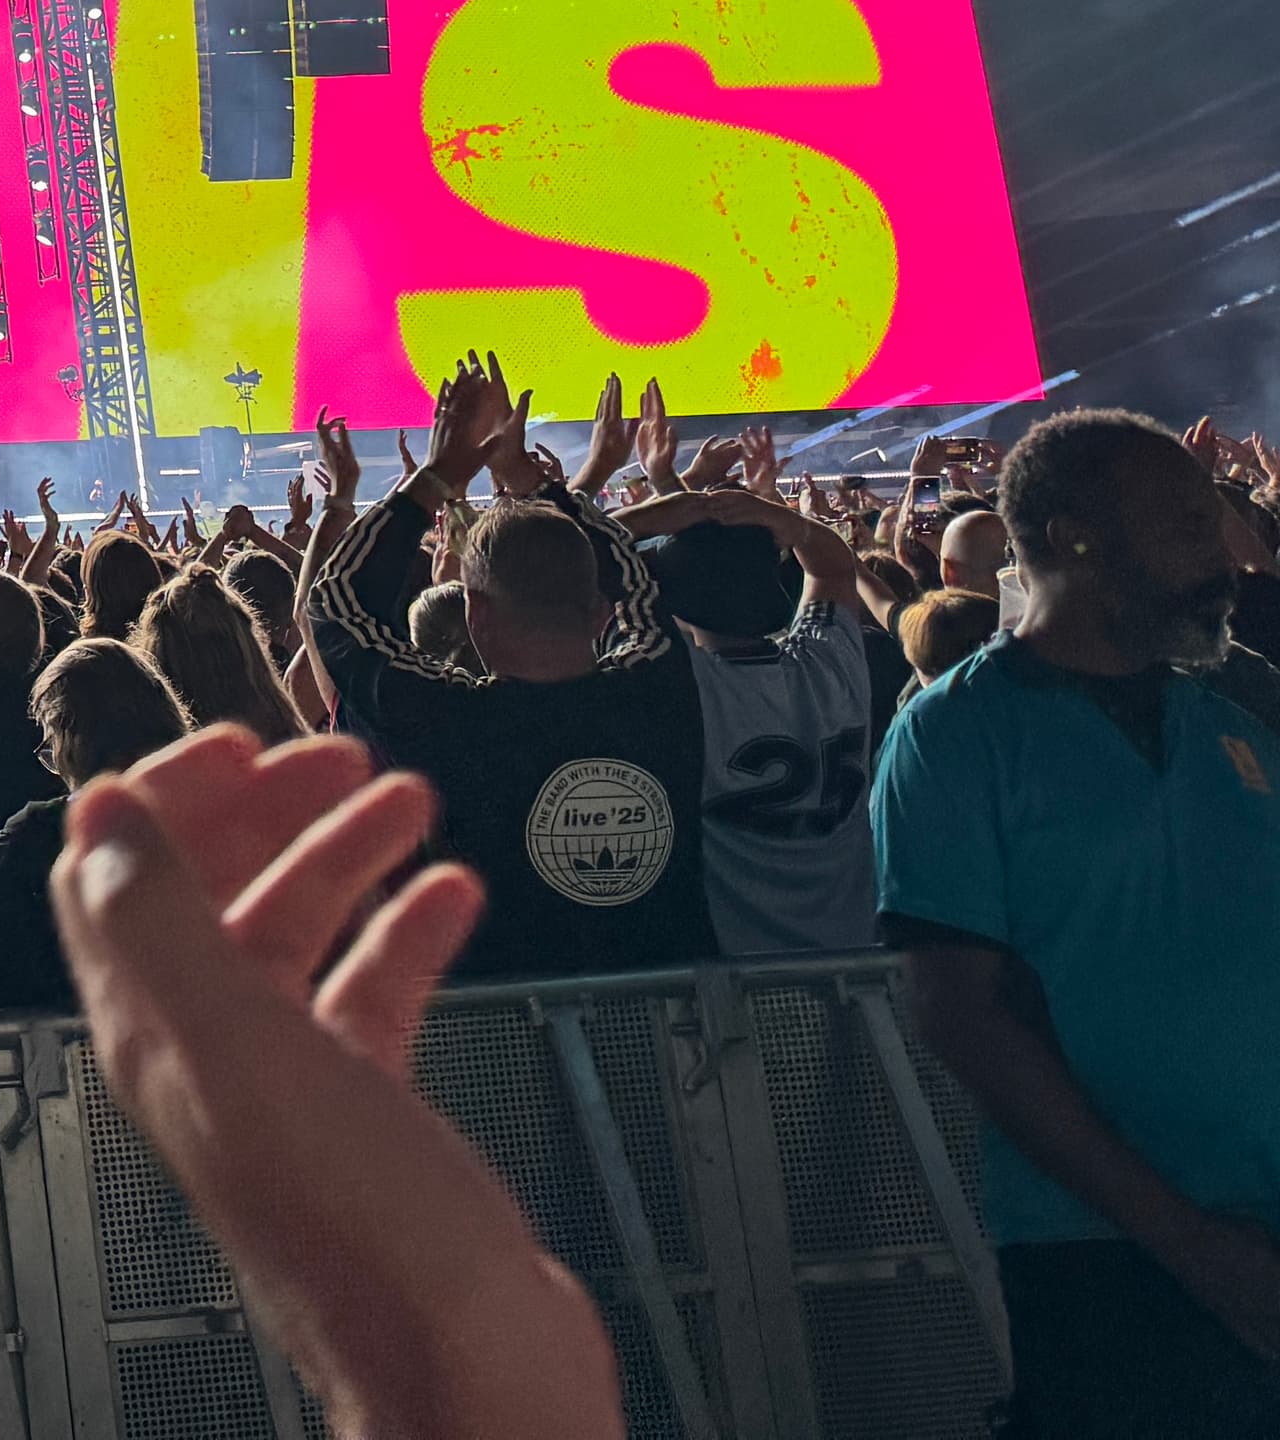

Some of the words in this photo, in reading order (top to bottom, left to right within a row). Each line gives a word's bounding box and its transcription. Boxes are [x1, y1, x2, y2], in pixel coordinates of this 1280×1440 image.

[537, 810, 551, 829] THE
[546, 778, 569, 807] BAND
[568, 767, 600, 782] WITH
[604, 767, 631, 781] THE
[631, 775, 639, 785] 3
[639, 782, 667, 823] STRIPES
[701, 726, 867, 838] 25
[563, 808, 607, 827] live
[611, 806, 647, 825] '25
